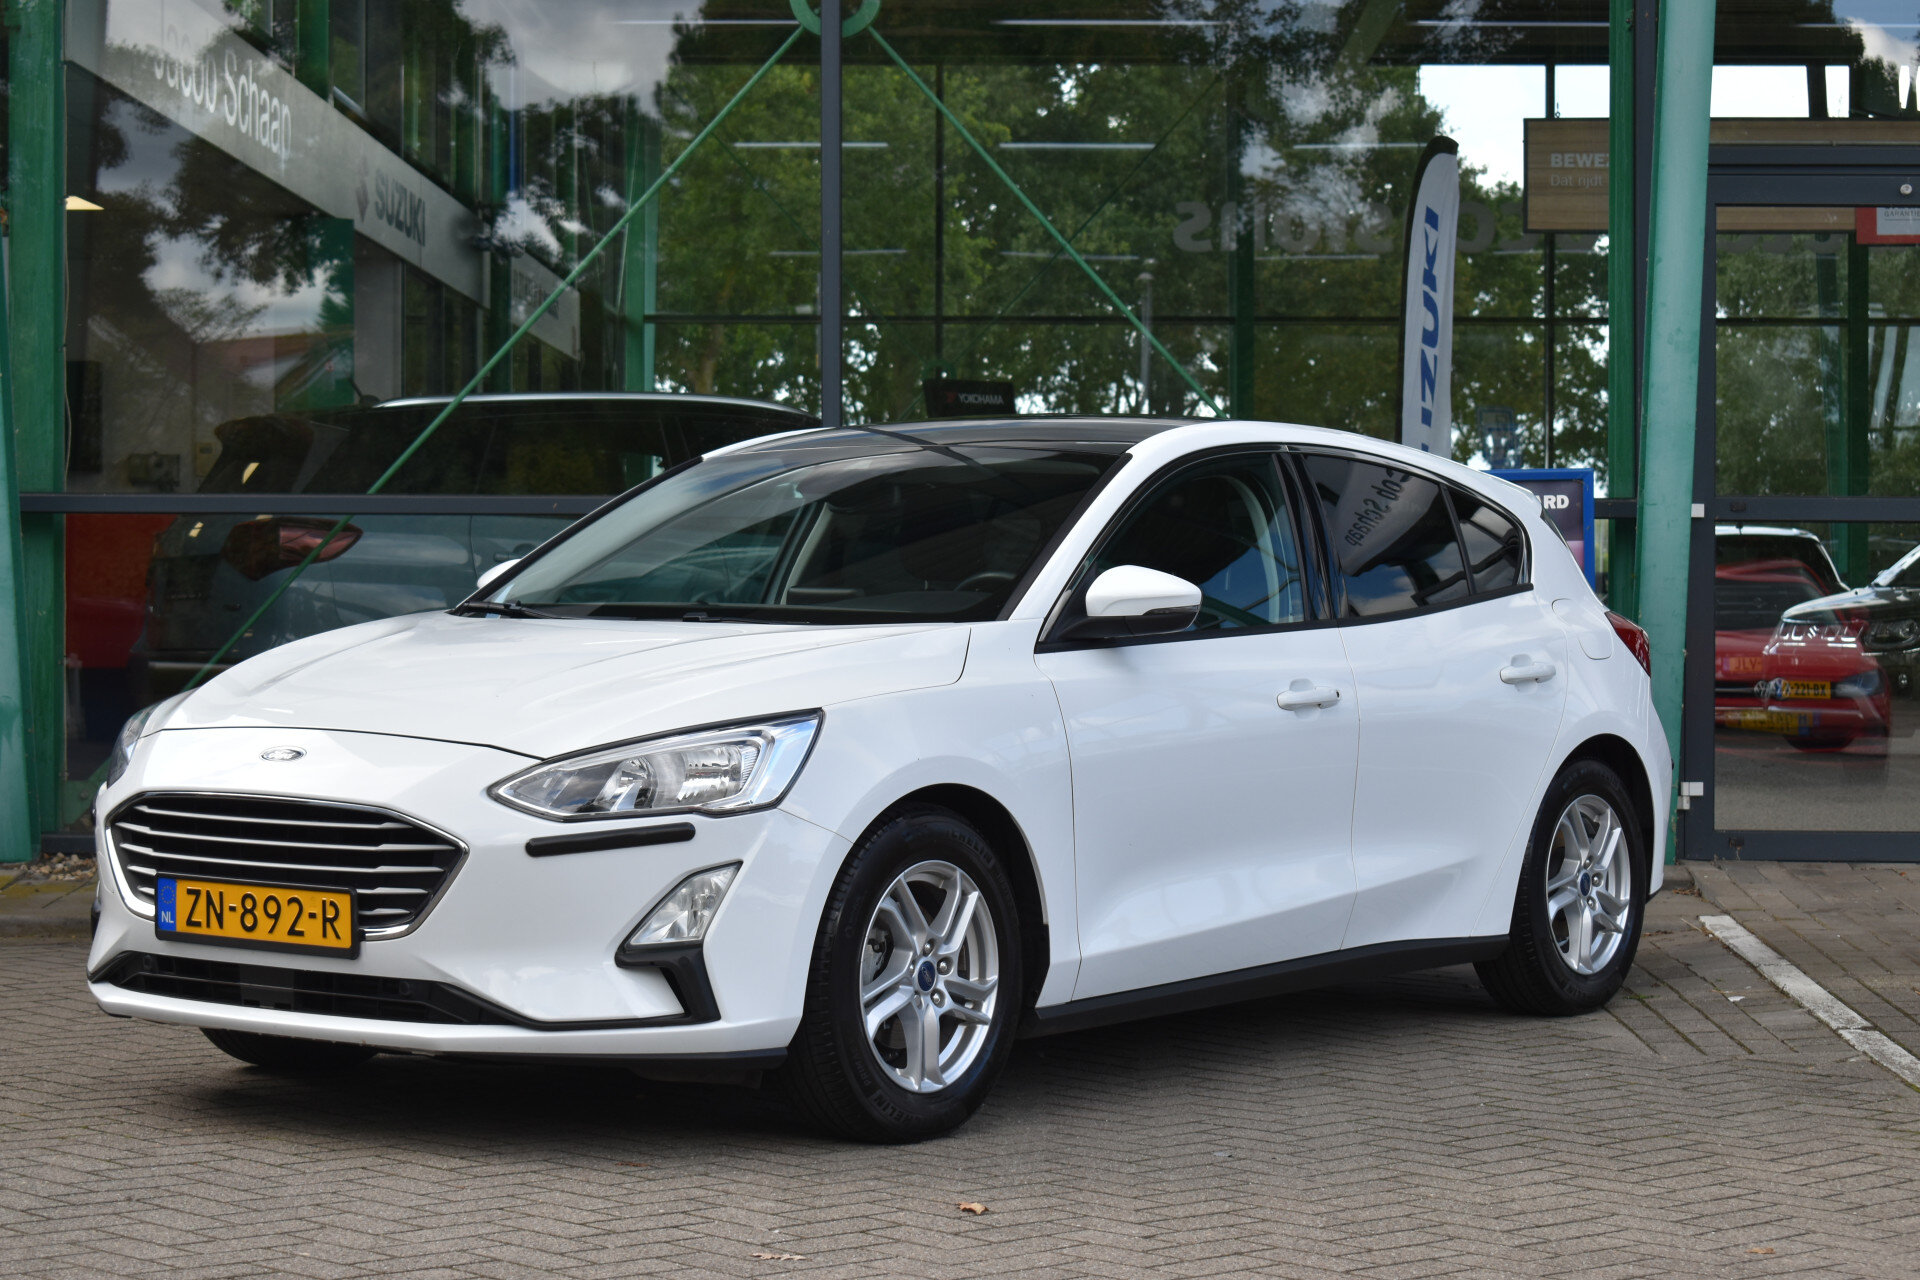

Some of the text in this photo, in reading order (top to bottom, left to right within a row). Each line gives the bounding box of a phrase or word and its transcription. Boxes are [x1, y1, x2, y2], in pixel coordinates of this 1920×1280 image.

[224, 50, 292, 174] Schaap
[1550, 173, 1603, 189] Dat rijdt
[374, 170, 426, 247] SUZUKI
[958, 393, 1004, 405] YOKOHAMA
[161, 910, 175, 924] NL
[186, 886, 342, 941] ZN-892-R
